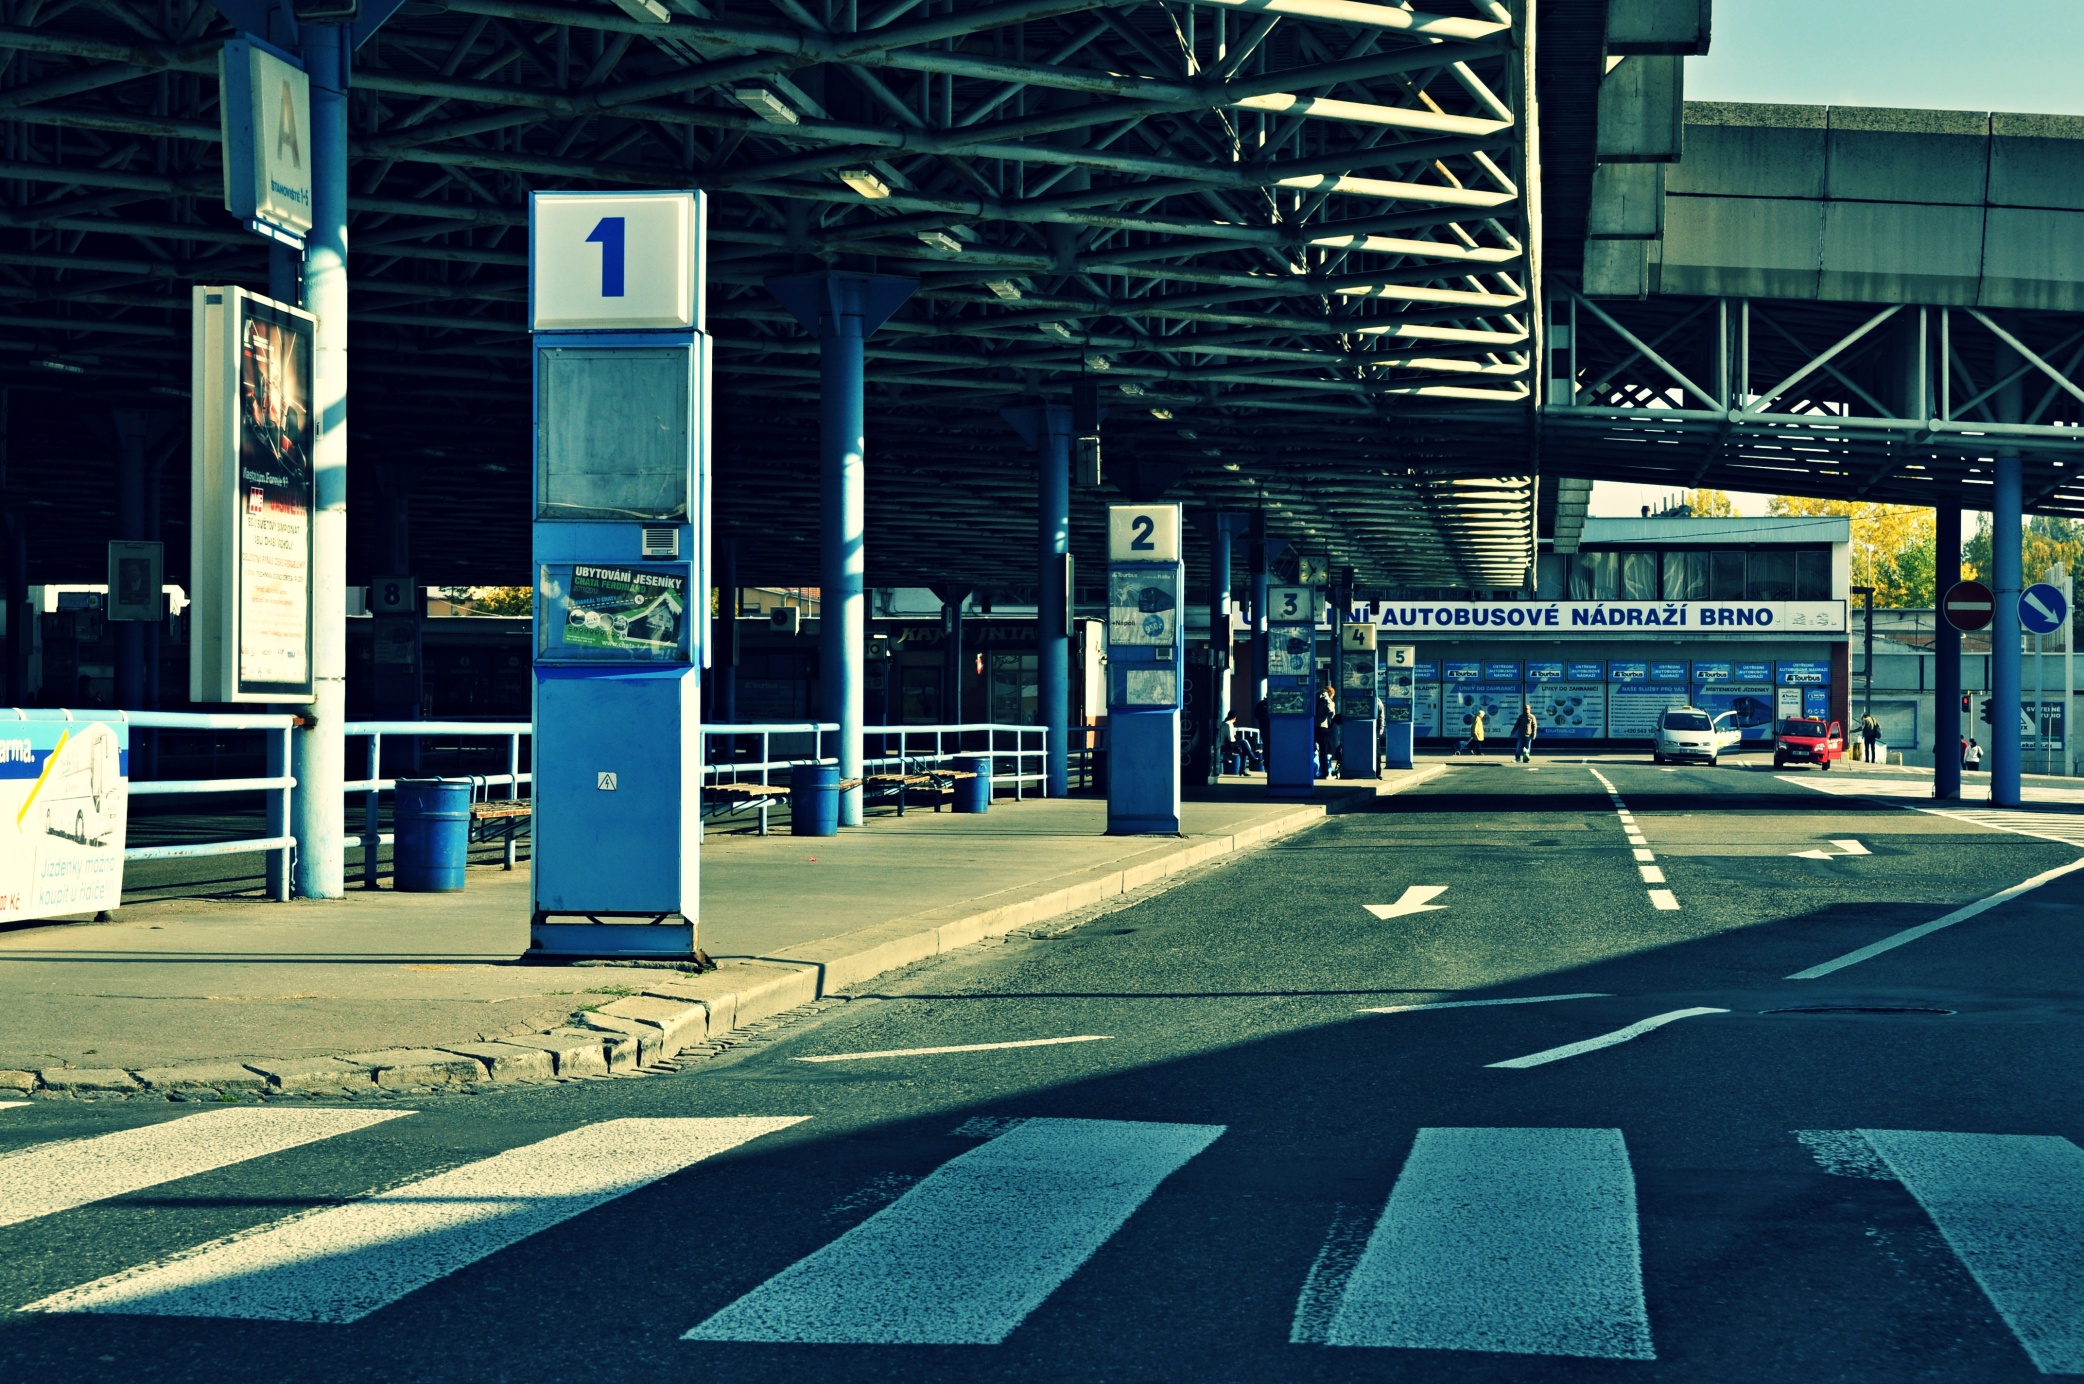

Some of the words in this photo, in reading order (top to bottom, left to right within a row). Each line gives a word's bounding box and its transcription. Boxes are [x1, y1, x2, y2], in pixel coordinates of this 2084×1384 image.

[276, 81, 301, 170] A
[585, 217, 625, 296] 1
[1131, 515, 1155, 550] 2
[574, 577, 600, 587] CHATA
[602, 580, 647, 593] FERDINAND
[576, 566, 631, 582] UBYTOVÁNÍ
[634, 574, 682, 589] JESENÍKY
[385, 583, 400, 605] 8
[1284, 593, 1297, 615] 3
[1381, 604, 1559, 626] AUTOBUSOVÉ
[1571, 603, 1688, 626] NÁDRAŽÍ
[1700, 607, 1774, 626] BRNO
[1353, 629, 1365, 645] 4
[865, 644, 879, 654] 10
[1396, 651, 1405, 663] 5
[1794, 674, 1820, 682] Tourbus
[41, 857, 82, 879] Jízdenky
[85, 855, 115, 875] možno
[10, 892, 20, 910] Kč
[39, 889, 69, 907] koupit
[71, 891, 77, 903] u
